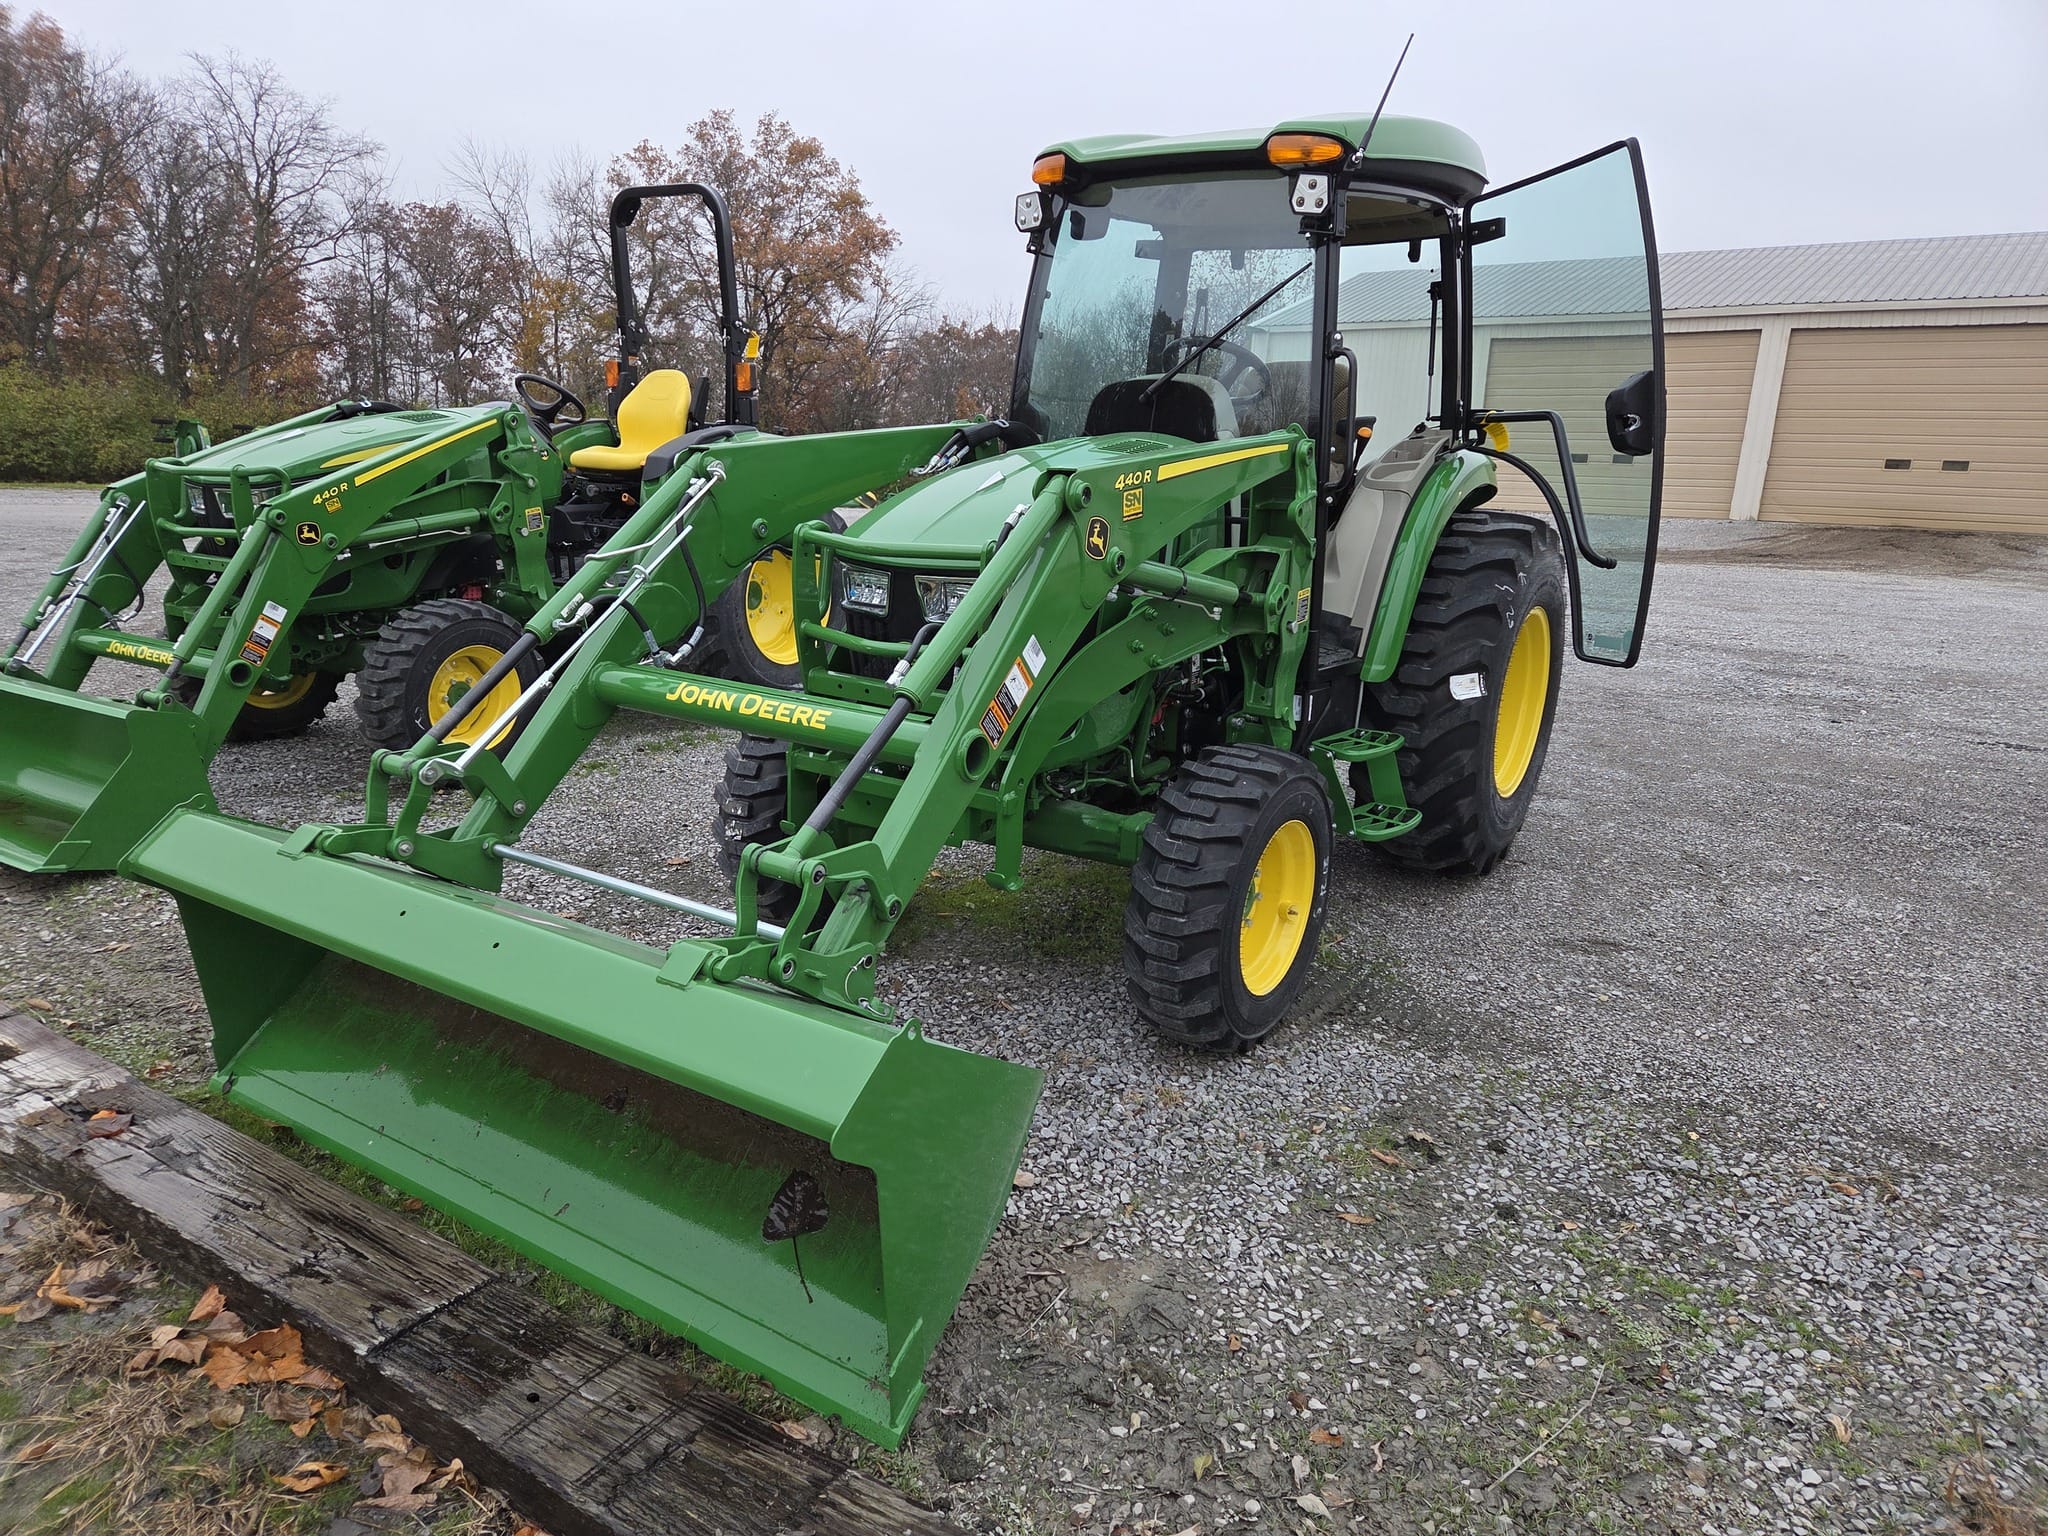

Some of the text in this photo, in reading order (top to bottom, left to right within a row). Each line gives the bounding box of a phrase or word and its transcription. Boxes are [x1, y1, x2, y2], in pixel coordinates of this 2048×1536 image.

[106, 640, 175, 665] JOHN DEERE
[666, 681, 833, 730] JOHN DEERE
